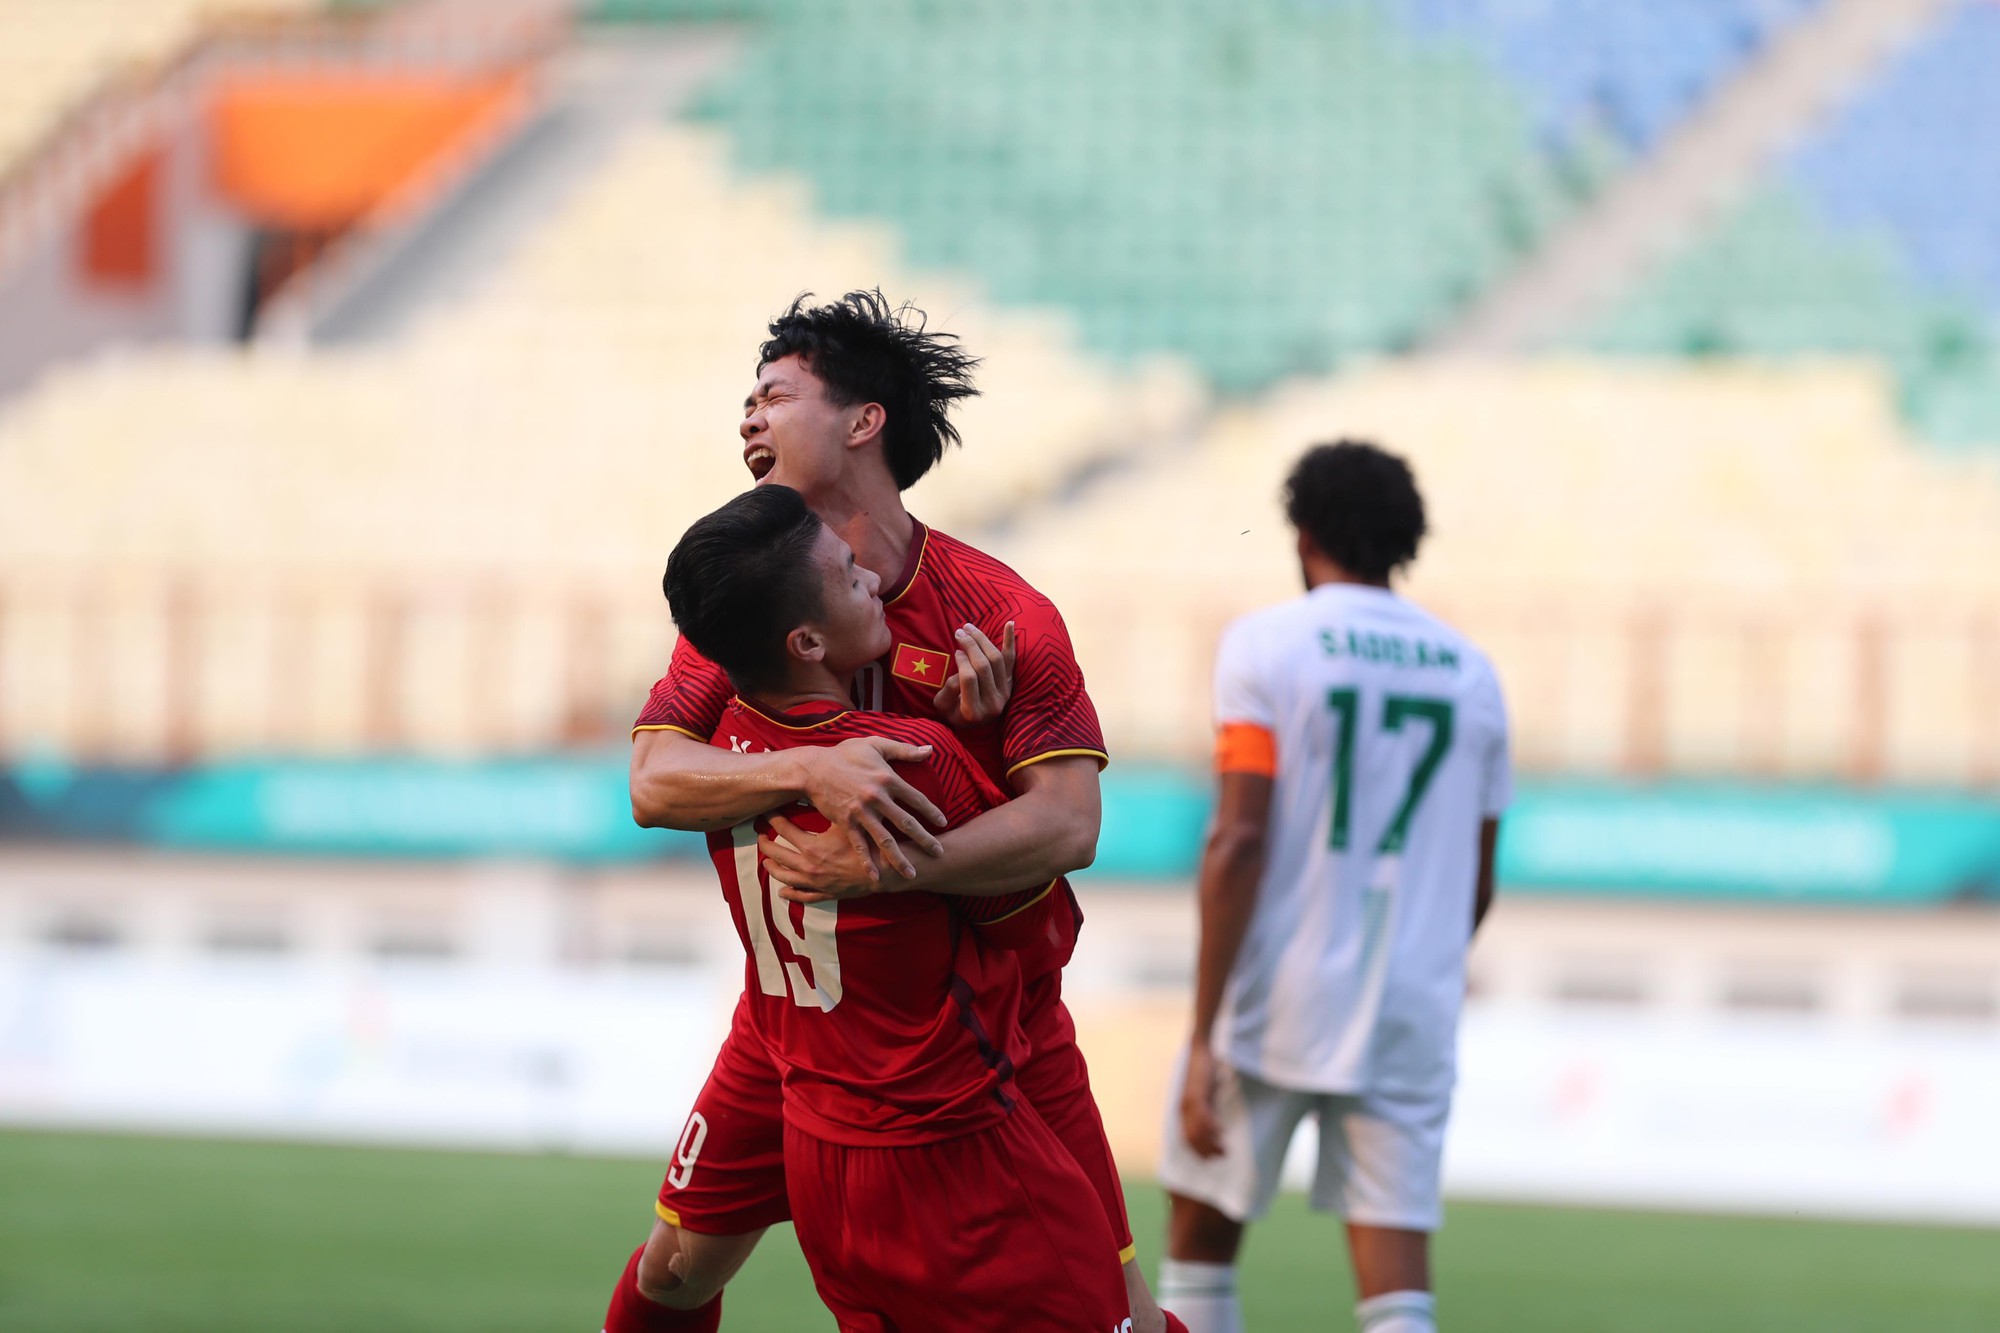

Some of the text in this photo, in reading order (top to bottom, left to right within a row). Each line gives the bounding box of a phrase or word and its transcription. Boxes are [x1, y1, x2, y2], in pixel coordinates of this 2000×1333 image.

[1326, 684, 1455, 855] 17
[731, 818, 843, 1014] 19
[667, 1110, 708, 1190] 9
